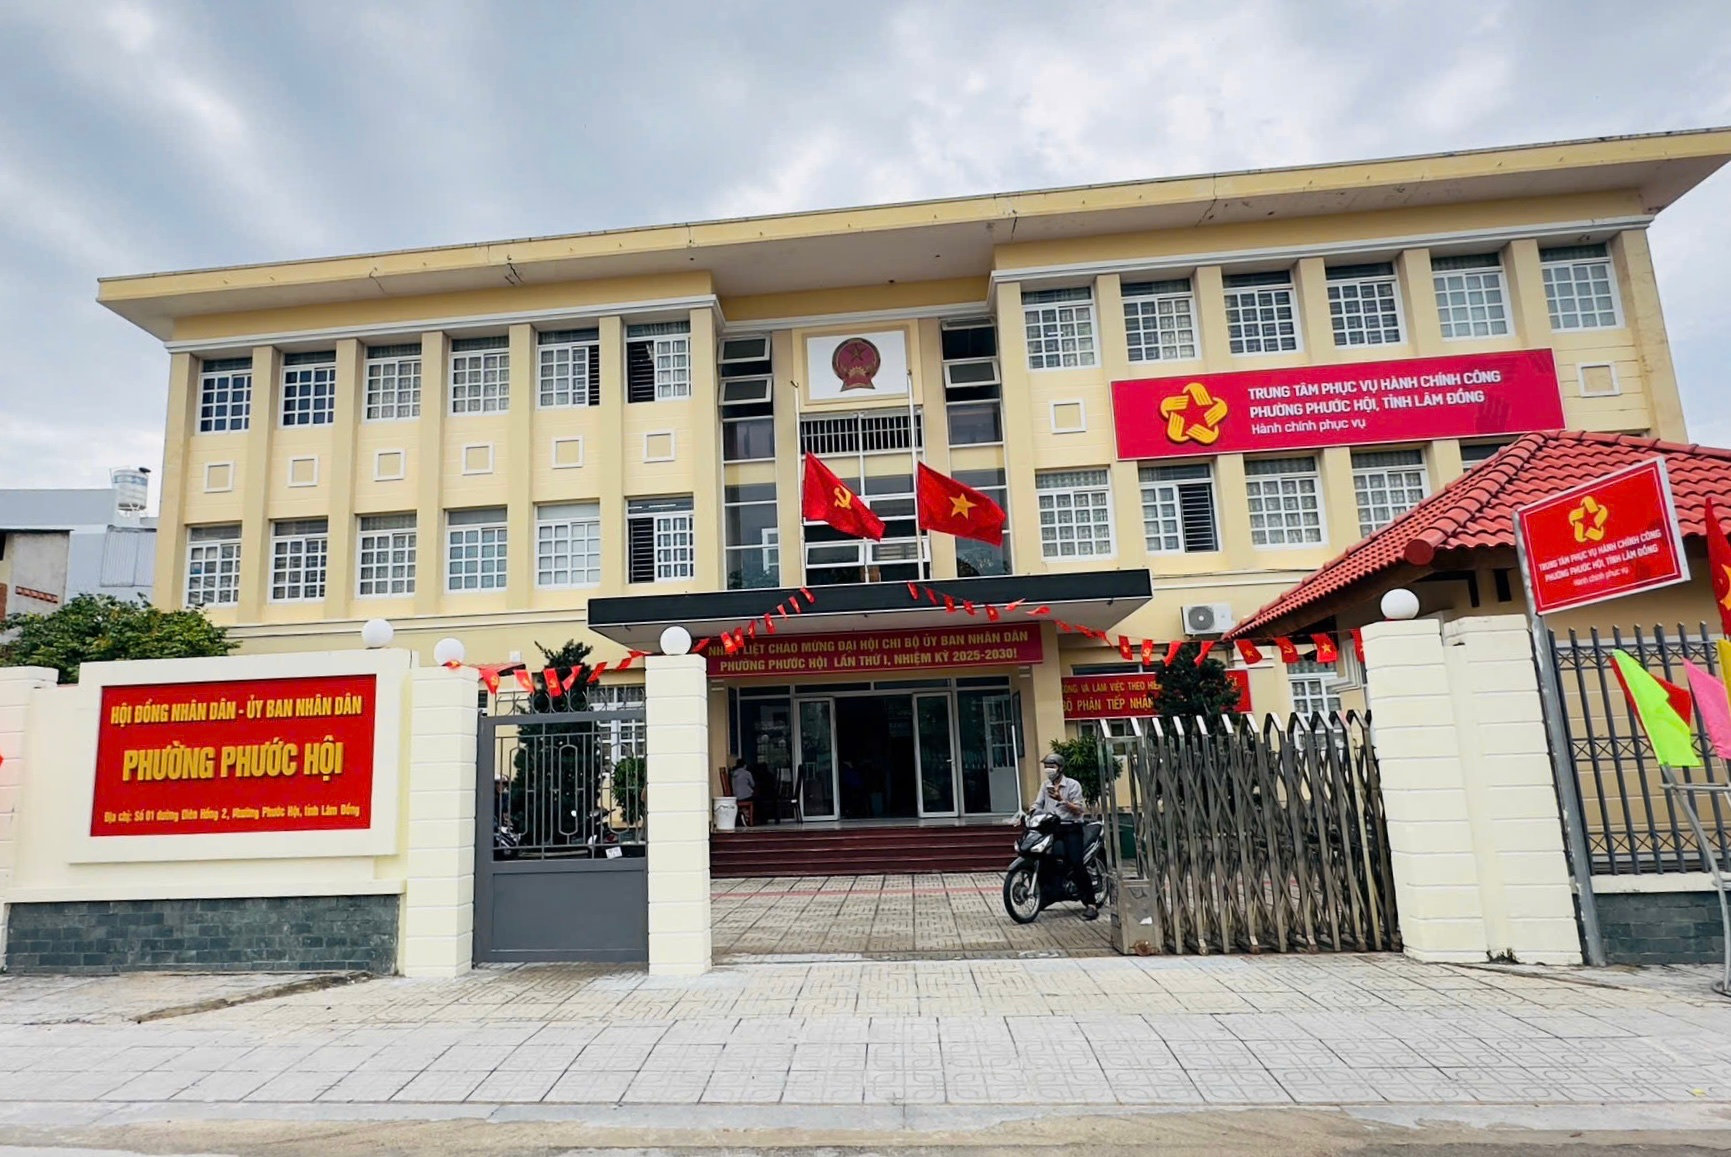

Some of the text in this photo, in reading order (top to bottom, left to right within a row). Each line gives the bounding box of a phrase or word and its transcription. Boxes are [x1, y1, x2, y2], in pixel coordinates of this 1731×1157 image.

[1248, 369, 1501, 401] TRUNG TÂM PHỤC VỤ HÀNH CHÍNH CÔNG
[1249, 388, 1485, 418] PHƯỜNG PHƯỚC HỘI, TỈNH LÂM ĐỒNG
[1251, 418, 1366, 434] Hành chính phục vụ
[1538, 560, 1558, 572] TRUNG
[1558, 556, 1570, 568] TÂM
[1598, 543, 1616, 556] HÀNH
[1617, 536, 1640, 551] CHÍNH
[1640, 528, 1662, 545] CÔNG
[1622, 548, 1637, 562] LÂM
[743, 643, 765, 656] LIỆT
[768, 639, 799, 654] CHÀO
[801, 636, 835, 652] MỪNG
[838, 640, 857, 652] ĐẠI
[860, 637, 879, 652] HỘI
[882, 638, 901, 649] CHI
[904, 635, 920, 649] BỘ
[923, 634, 937, 647] ỦY
[940, 634, 964, 646] BAN
[968, 630, 1000, 645] NHÂN
[720, 658, 765, 672] PHƯỜNG
[768, 656, 806, 671] PHƯỚC
[808, 656, 827, 670] HỘI
[858, 653, 881, 666] THỨ
[894, 650, 932, 666] NHIỆM
[934, 650, 950, 662] KỲ
[952, 648, 1018, 662] 2025-2030!
[1110, 680, 1124, 692] VIỆC
[1128, 681, 1146, 691] THEO
[110, 702, 132, 728] HỘI
[134, 698, 169, 723] ĐỒNG
[171, 699, 207, 722] NHÂN
[209, 698, 236, 720] DÂN
[246, 694, 264, 719] ỦY
[266, 698, 293, 718] BAN
[296, 694, 332, 717] NHÂN
[334, 692, 362, 715] DÂN
[1076, 696, 1102, 713] PHẬN
[1106, 694, 1125, 710] TIẾP
[122, 734, 344, 782] PHƯỜNG PHƯỚC HỘI
[134, 808, 145, 822] Số
[145, 809, 154, 821] 01
[221, 808, 230, 820] 2,
[232, 806, 260, 820] Phường
[262, 804, 286, 818] Phước
[321, 804, 338, 816] Lâm
